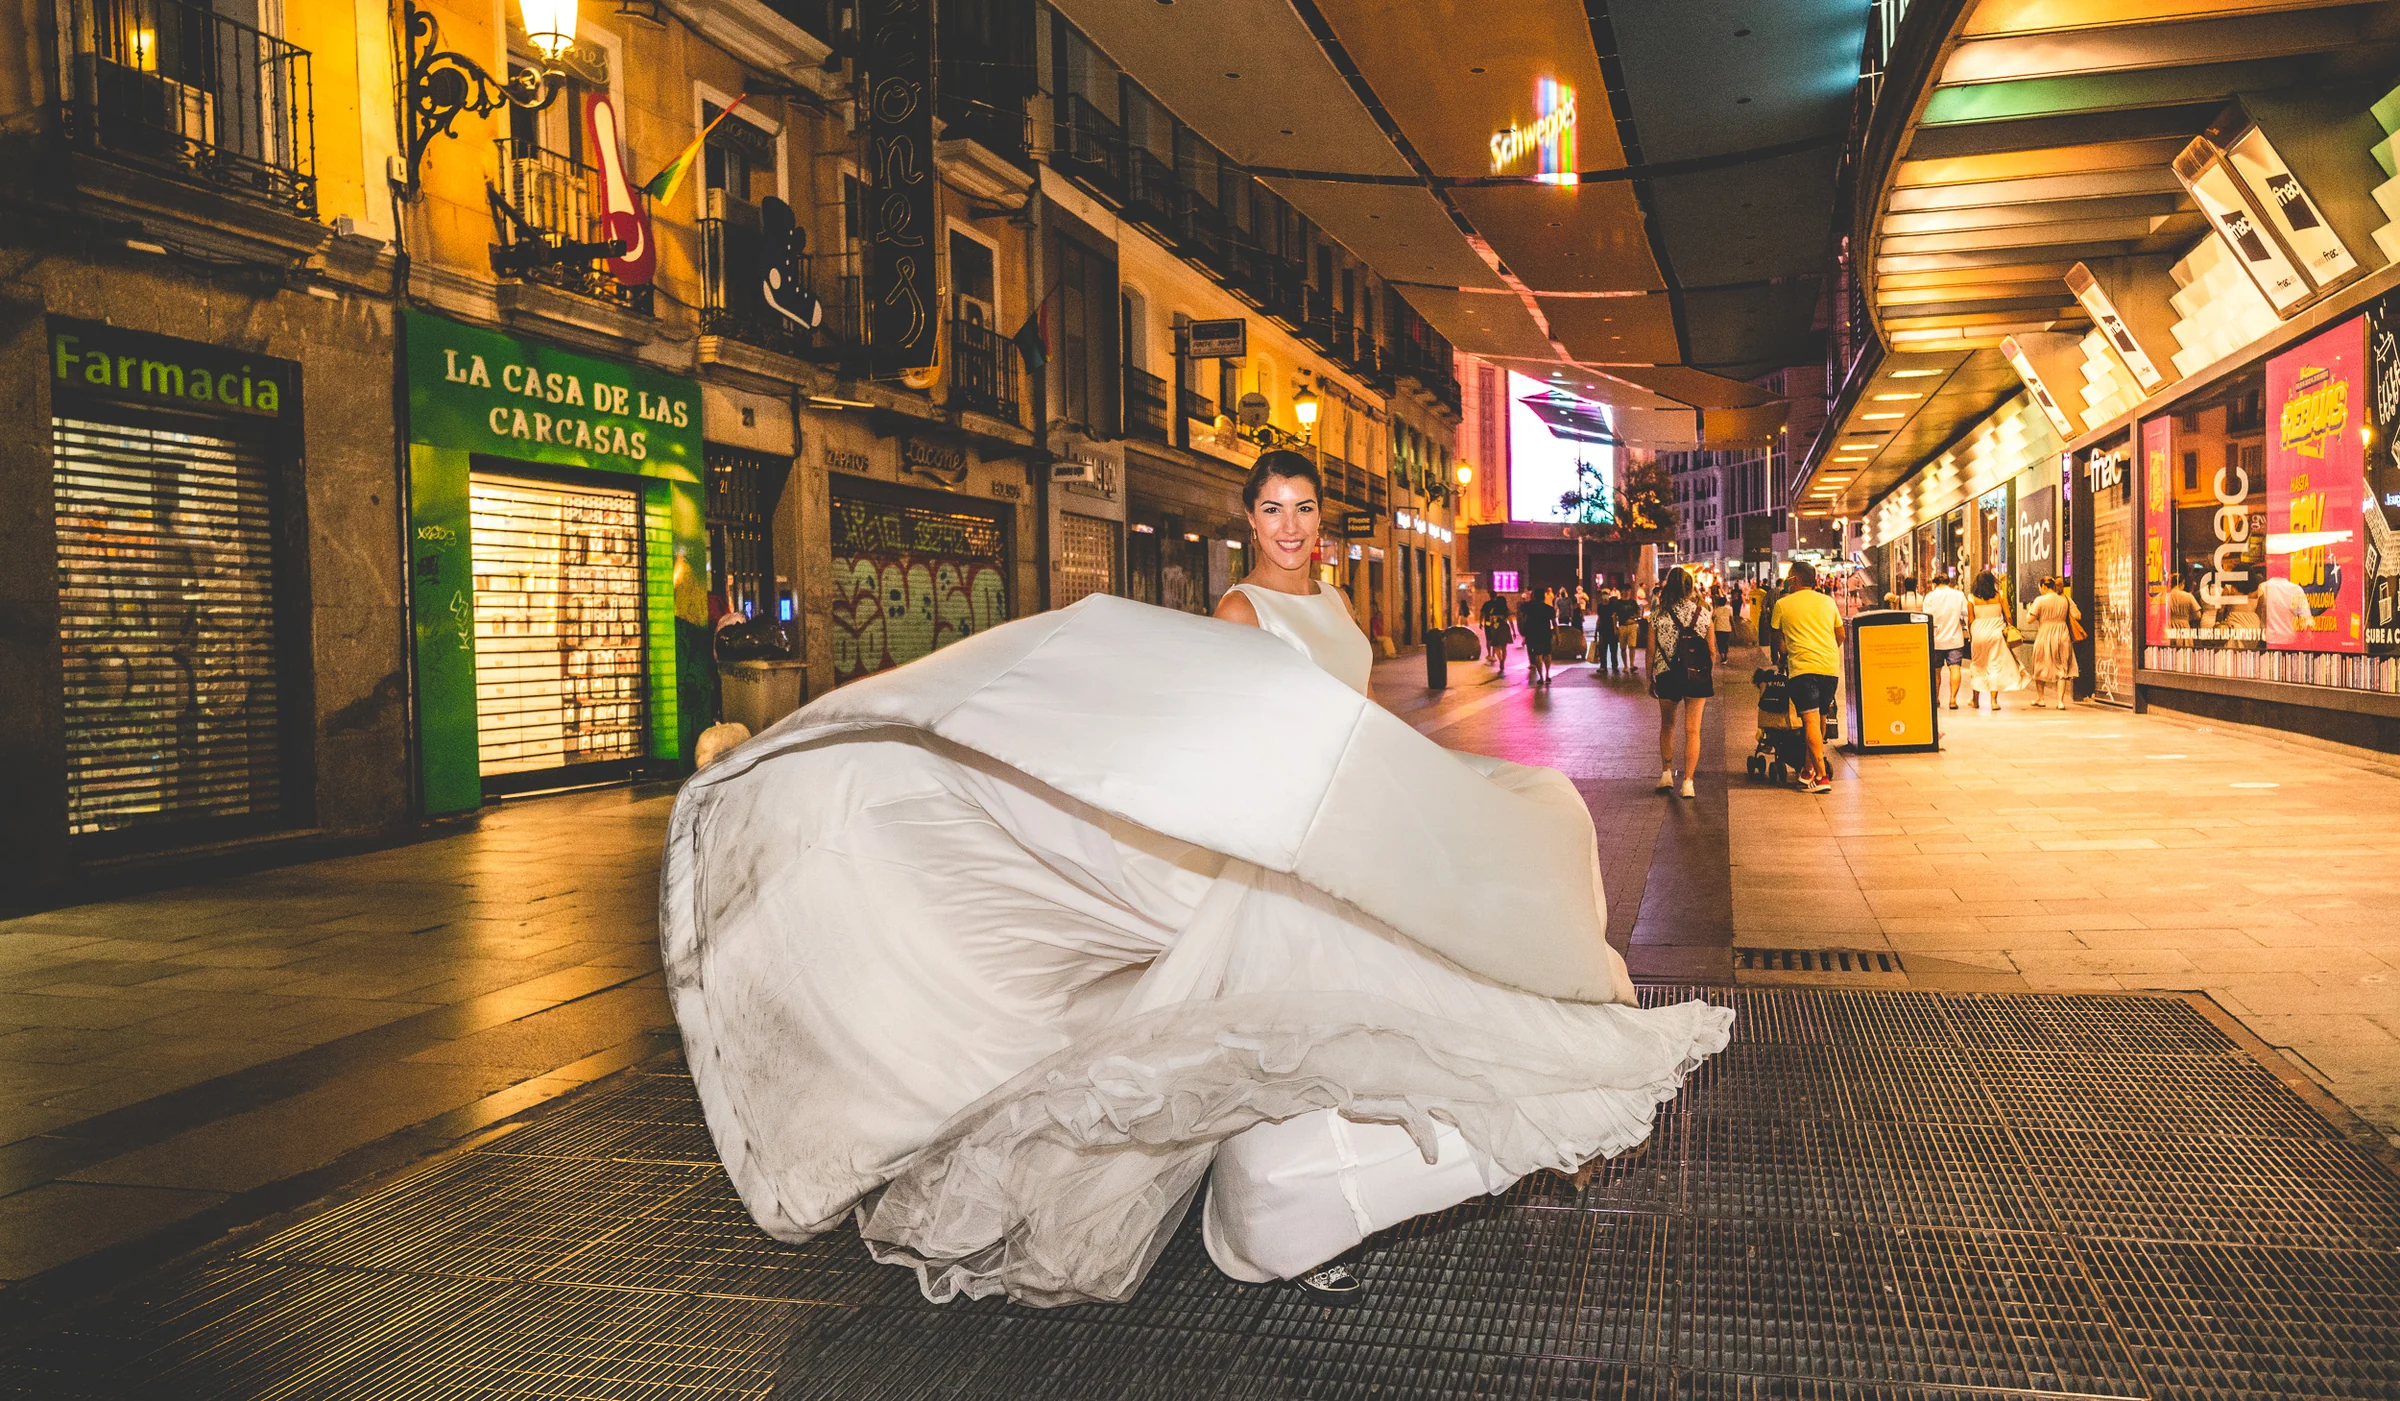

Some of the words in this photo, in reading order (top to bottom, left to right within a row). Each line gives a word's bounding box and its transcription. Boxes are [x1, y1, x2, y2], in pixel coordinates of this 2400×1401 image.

[1490, 97, 1577, 174] Schweppes
[2271, 179, 2300, 207] fnac
[2226, 216, 2252, 241] fnac
[56, 334, 279, 412] Farmacia
[444, 349, 491, 388] LA
[503, 364, 584, 406] CASA
[594, 382, 629, 415] DE
[638, 391, 689, 428] LAS
[489, 407, 647, 460] CARCASAS
[2090, 447, 2123, 493] fnac
[2290, 474, 2310, 492] HASTA
[2020, 511, 2050, 565] fnac
[2200, 467, 2249, 609] fnac
[2366, 628, 2385, 644] SUBE
[2386, 629, 2393, 644] A
